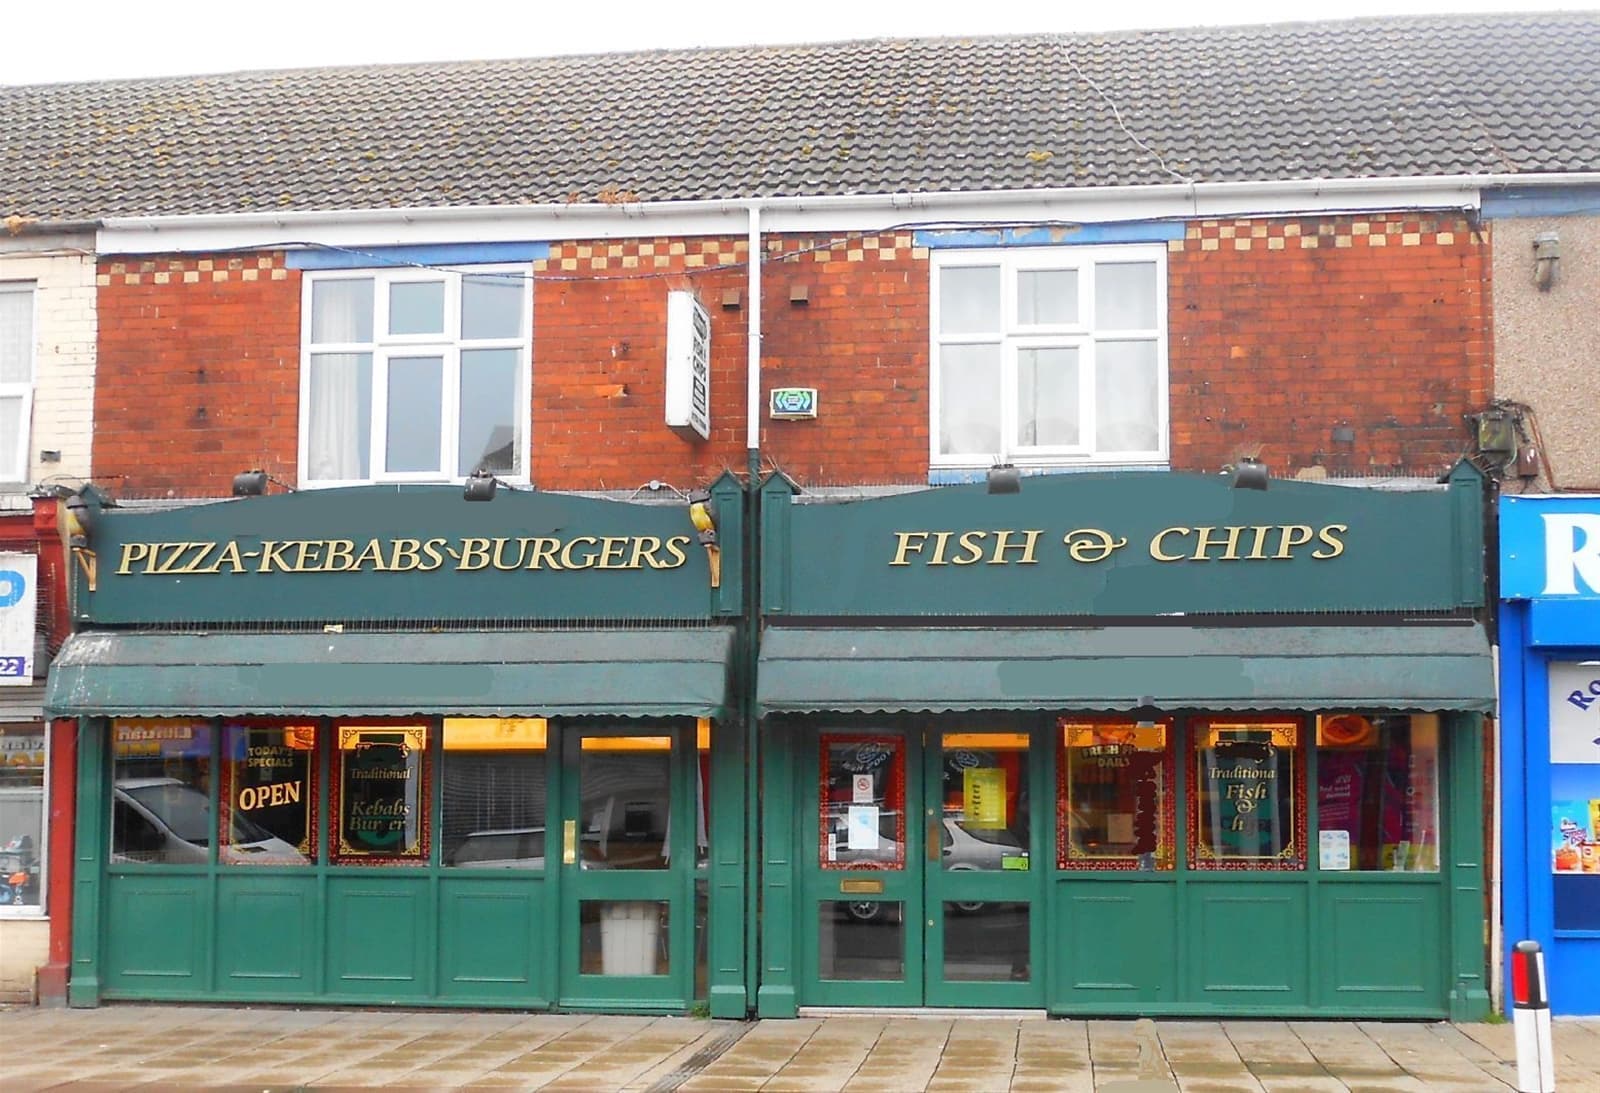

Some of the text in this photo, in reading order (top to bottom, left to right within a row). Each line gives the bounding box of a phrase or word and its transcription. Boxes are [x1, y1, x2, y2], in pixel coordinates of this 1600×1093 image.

[888, 529, 1046, 566] FISH
[1149, 524, 1348, 562] CHIPS
[248, 758, 294, 768] SPECIALS
[240, 781, 301, 811] OPEN
[1226, 782, 1267, 800] Fish
[352, 799, 411, 816] Kebabs
